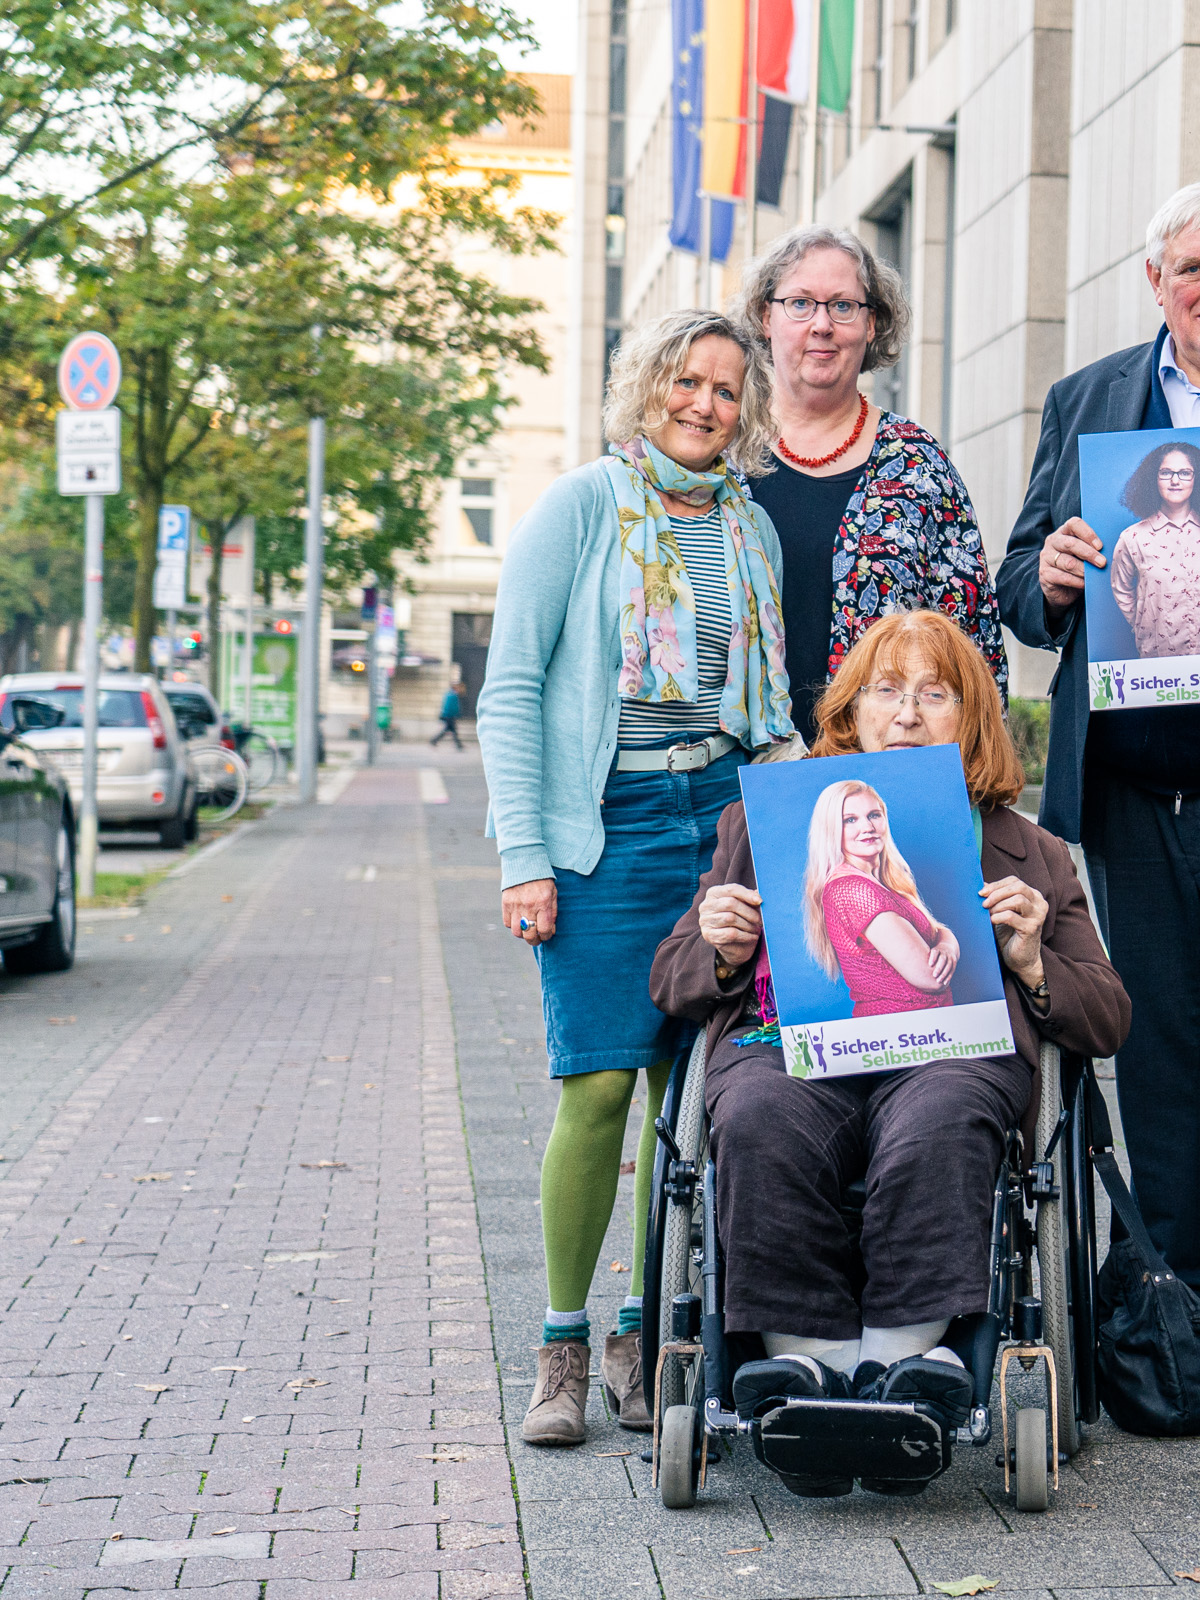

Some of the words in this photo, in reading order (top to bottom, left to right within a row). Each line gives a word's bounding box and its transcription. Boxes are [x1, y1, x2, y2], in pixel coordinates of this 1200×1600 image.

[161, 510, 182, 548] P
[1130, 675, 1185, 691] Sicher.
[831, 1038, 893, 1057] Sicher.
[897, 1029, 953, 1048] Stark.
[862, 1036, 1014, 1068] Selbstbestimmt.
